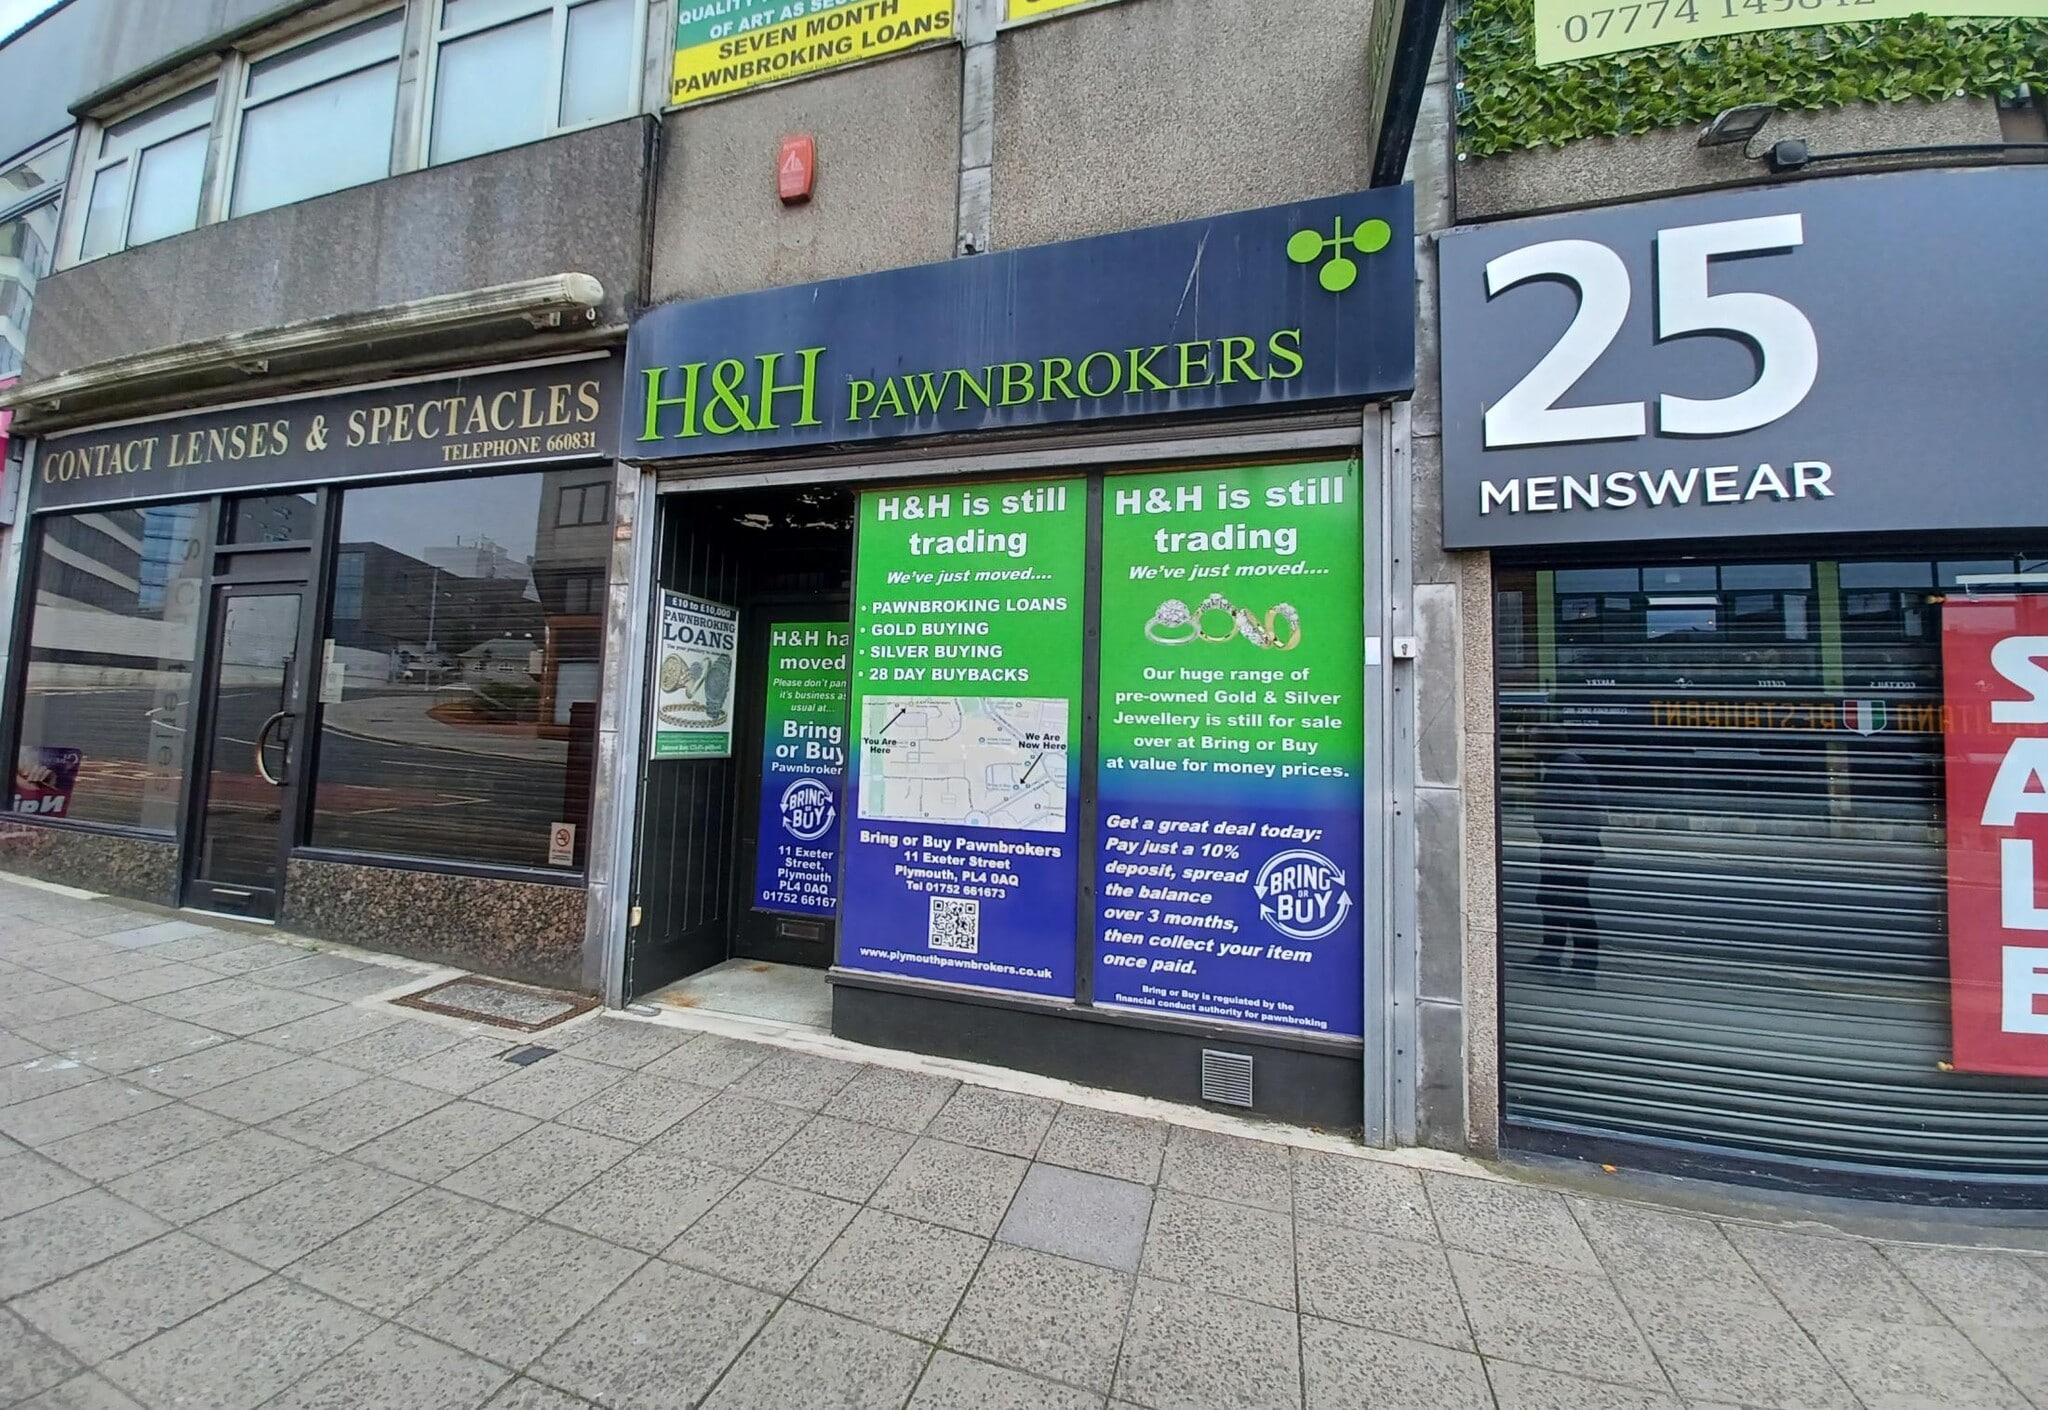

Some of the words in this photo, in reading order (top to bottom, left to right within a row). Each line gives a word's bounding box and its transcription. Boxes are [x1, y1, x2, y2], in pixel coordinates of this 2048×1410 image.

[710, 22, 733, 39] OF
[739, 9, 775, 32] ART
[780, 6, 804, 21] AS
[719, 25, 797, 60] SEVEN
[806, 0, 899, 37] MONTH
[1564, 0, 1700, 43] 07774
[674, 36, 853, 96] PAWNBROKING
[862, 11, 950, 49] LOANS
[1484, 213, 1818, 447] 25
[637, 347, 826, 443] H&H
[846, 328, 1304, 421] PAWNBROKERS
[44, 437, 159, 484] CONTACT
[168, 420, 290, 467] LENSES
[305, 415, 329, 452] &
[347, 380, 600, 447] SPECTACLES
[442, 436, 541, 462] TELEPHONE
[546, 432, 595, 451] 660831
[1116, 486, 1202, 515] H&H
[1218, 484, 1250, 510] is
[1266, 476, 1343, 508] still
[1481, 462, 1834, 512] MENSWEAR
[878, 494, 950, 521] H&H
[963, 493, 989, 517] is
[1002, 486, 1066, 514] still
[909, 529, 1027, 558] trading
[1155, 524, 1297, 555] trading
[887, 572, 933, 584] We've
[936, 570, 970, 586] just
[975, 568, 1052, 582] moved....
[1129, 566, 1185, 579] We've
[1188, 564, 1230, 581] just
[1236, 561, 1329, 577] moved....
[672, 597, 688, 608] £10
[690, 602, 698, 610] to
[700, 605, 731, 617] £10,000
[872, 600, 1000, 614] PAWNBROKING
[1006, 598, 1067, 612] LOANS
[664, 610, 735, 633] PAWNBROKING
[872, 624, 916, 636] GOLD
[922, 623, 989, 635] BUYING
[664, 623, 734, 650] LOANS
[773, 631, 819, 646] H&H
[780, 654, 846, 670] moved
[870, 646, 928, 658] SILVER
[934, 646, 1002, 658] BUYING
[773, 678, 802, 687] Please
[804, 679, 827, 687] don't
[869, 668, 888, 681] 28
[894, 668, 926, 680] DAY
[932, 668, 1029, 682] BUYBACKS
[1144, 668, 1174, 680] Our
[1180, 668, 1224, 683] huge
[1230, 670, 1284, 684] range
[1290, 668, 1310, 680] of
[780, 690, 792, 699] it's
[795, 691, 835, 700] business
[1116, 691, 1208, 704] pre-owned
[1214, 691, 1256, 704] Gold
[1264, 692, 1277, 704] &
[1284, 692, 1341, 705] Silver
[791, 704, 815, 712] usual
[1114, 712, 1200, 729] Jewellery
[1206, 714, 1221, 726] is
[1228, 714, 1262, 727] still
[1268, 714, 1295, 728] for
[1302, 715, 1343, 728] sale
[784, 720, 841, 744] Bring
[882, 738, 897, 746] Are
[1026, 733, 1040, 741] We
[776, 744, 799, 758] or
[806, 742, 844, 765] Buy
[870, 746, 891, 754] Here
[1043, 742, 1067, 750] Here
[1134, 737, 1172, 747] over
[1178, 736, 1195, 748] at
[1202, 736, 1250, 752] Bring
[1256, 740, 1276, 751] or
[1282, 738, 1318, 755] Buy
[1106, 756, 1124, 769] at
[1130, 758, 1177, 771] value
[1182, 758, 1206, 772] for
[1214, 764, 1276, 778] money
[1282, 764, 1350, 778] prices.
[790, 788, 824, 811] BRING
[793, 806, 825, 829] BUY
[1107, 815, 1138, 829] Get
[1142, 820, 1153, 830] a
[1158, 819, 1209, 834] great
[1213, 821, 1254, 836] deal
[1260, 824, 1322, 840] today:
[860, 831, 898, 848] Bring
[902, 836, 918, 847] or
[923, 836, 952, 852] Buy
[956, 838, 1062, 858] Pawnbrokers
[1980, 636, 2048, 1033] SALE
[778, 846, 791, 855] 11
[796, 847, 834, 859] Exeter
[1106, 838, 1140, 855] Pay
[1141, 839, 1178, 857] just
[1182, 844, 1194, 856] a
[1201, 844, 1239, 860] 10%
[786, 857, 824, 872] Street,
[904, 851, 918, 862] 11
[924, 853, 965, 866] Exeter
[969, 857, 1011, 870] Street
[778, 868, 831, 882] Plymouth
[895, 865, 958, 882] Plymouth,
[962, 871, 987, 884] PL4
[991, 874, 1019, 887] 0AQ
[1105, 861, 1176, 881] deposit,
[1182, 869, 1248, 883] spread
[1270, 864, 1331, 896] BRING
[763, 891, 797, 903] 01752
[780, 880, 800, 891] PL4
[804, 883, 828, 895] 0AQ
[906, 880, 923, 891] Tel
[926, 882, 960, 894] 01752
[964, 886, 1005, 899] 661673
[1105, 883, 1134, 898] the
[1138, 886, 1212, 904] balance
[1298, 890, 1309, 898] OR
[1278, 891, 1332, 923] BUY
[1104, 908, 1143, 921] over
[1148, 910, 1159, 922] 3
[1164, 914, 1239, 933] months,
[1104, 929, 1143, 944] then
[1149, 935, 1215, 952] collect
[1218, 943, 1262, 958] your
[1267, 945, 1313, 963] item
[860, 948, 1052, 979] www.plymouthpawnbrokers.co.uk
[1104, 954, 1147, 968] once
[1151, 958, 1197, 975] paid.
[1142, 985, 1166, 997] Bring
[1182, 990, 1200, 1000] Buy
[1202, 992, 1210, 1000] is
[1213, 993, 1260, 1007] regulated
[1263, 1000, 1275, 1011] by
[1278, 1002, 1294, 1011] the
[1116, 994, 1155, 1005] financial
[1158, 999, 1196, 1011] conduct
[1198, 1004, 1242, 1018] authority
[1244, 1010, 1259, 1019] for
[1261, 1013, 1327, 1029] pawnbroking
